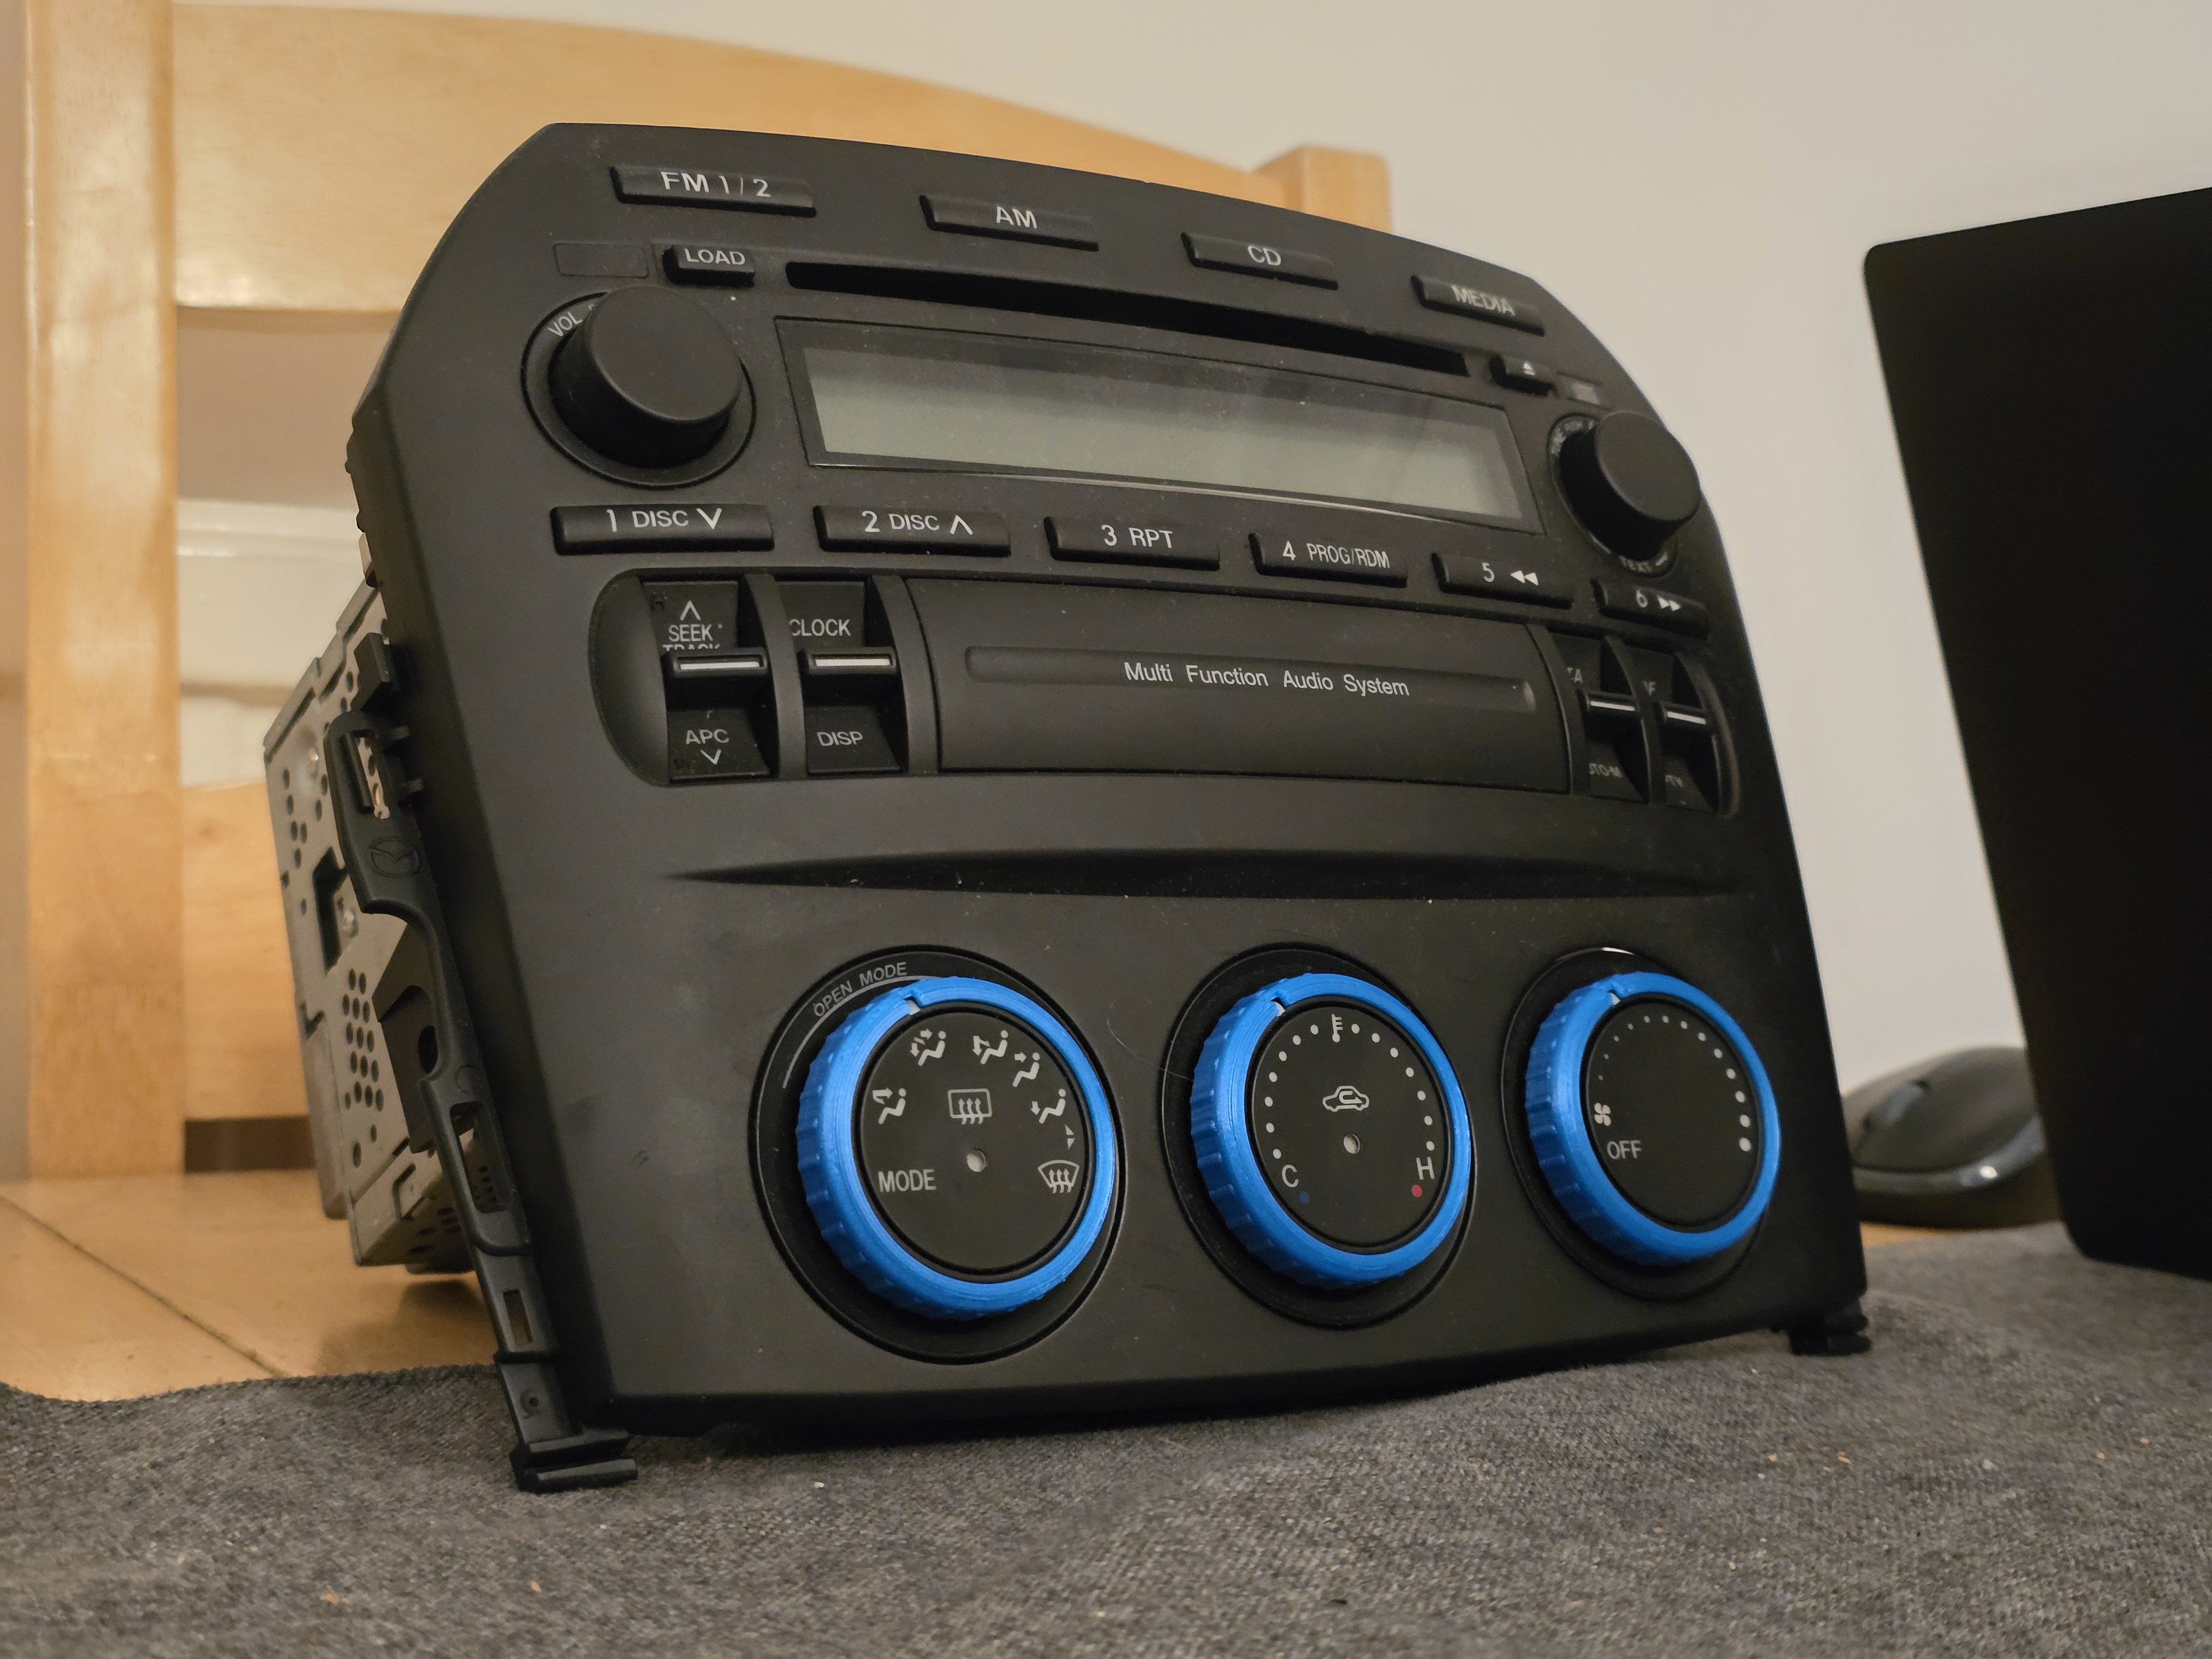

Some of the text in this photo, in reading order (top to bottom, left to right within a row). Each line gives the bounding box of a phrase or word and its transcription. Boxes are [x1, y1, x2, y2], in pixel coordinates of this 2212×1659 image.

[660, 171, 709, 193] FM
[996, 206, 1037, 229] AM
[684, 248, 745, 265] LOAD
[1247, 245, 1281, 266] CD
[1451, 284, 1516, 316] MEDIA
[547, 311, 583, 337] VOL
[606, 509, 689, 533] 1 DISC
[862, 510, 940, 533] 2 DISC
[1101, 524, 1173, 549] 3 RPT
[1282, 540, 1390, 568] 4 PROG/RDM
[1481, 562, 1495, 582] 5
[1636, 589, 1648, 608] 6
[669, 624, 713, 642] SEEK
[789, 618, 851, 637] CLOCK
[1124, 662, 1410, 697] Multi Function Audio System
[686, 728, 729, 745] APC
[817, 731, 863, 747] DISP
[813, 962, 907, 1016] OPEN MODE
[1606, 1140, 1642, 1160] OFF
[1281, 1164, 1299, 1188] C
[1416, 1156, 1435, 1180] H
[878, 1169, 936, 1193] MODE
